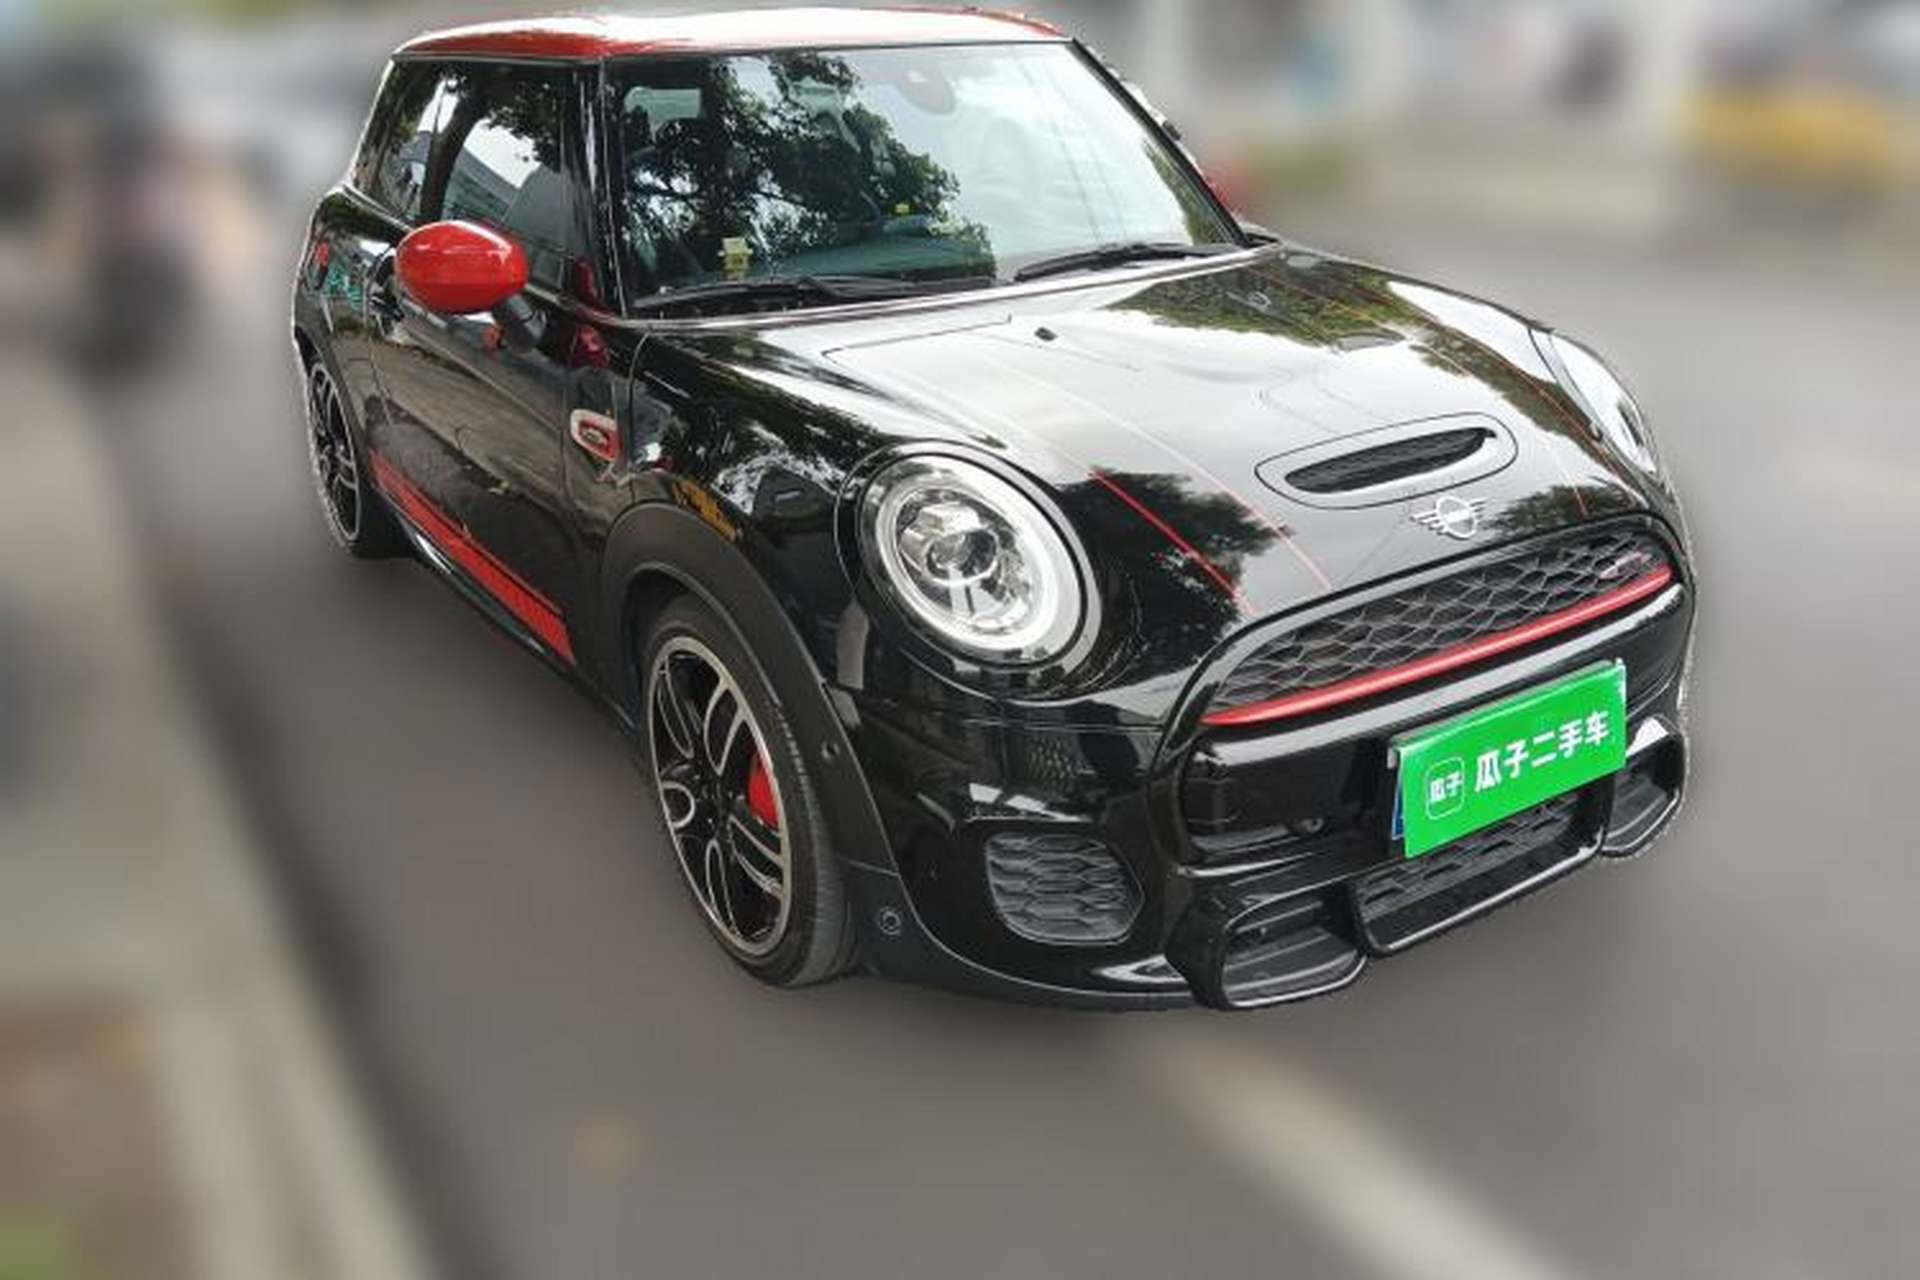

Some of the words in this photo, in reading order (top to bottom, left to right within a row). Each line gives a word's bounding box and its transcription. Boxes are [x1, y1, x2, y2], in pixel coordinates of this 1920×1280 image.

[1475, 711, 1609, 792] 瓜子二手车
